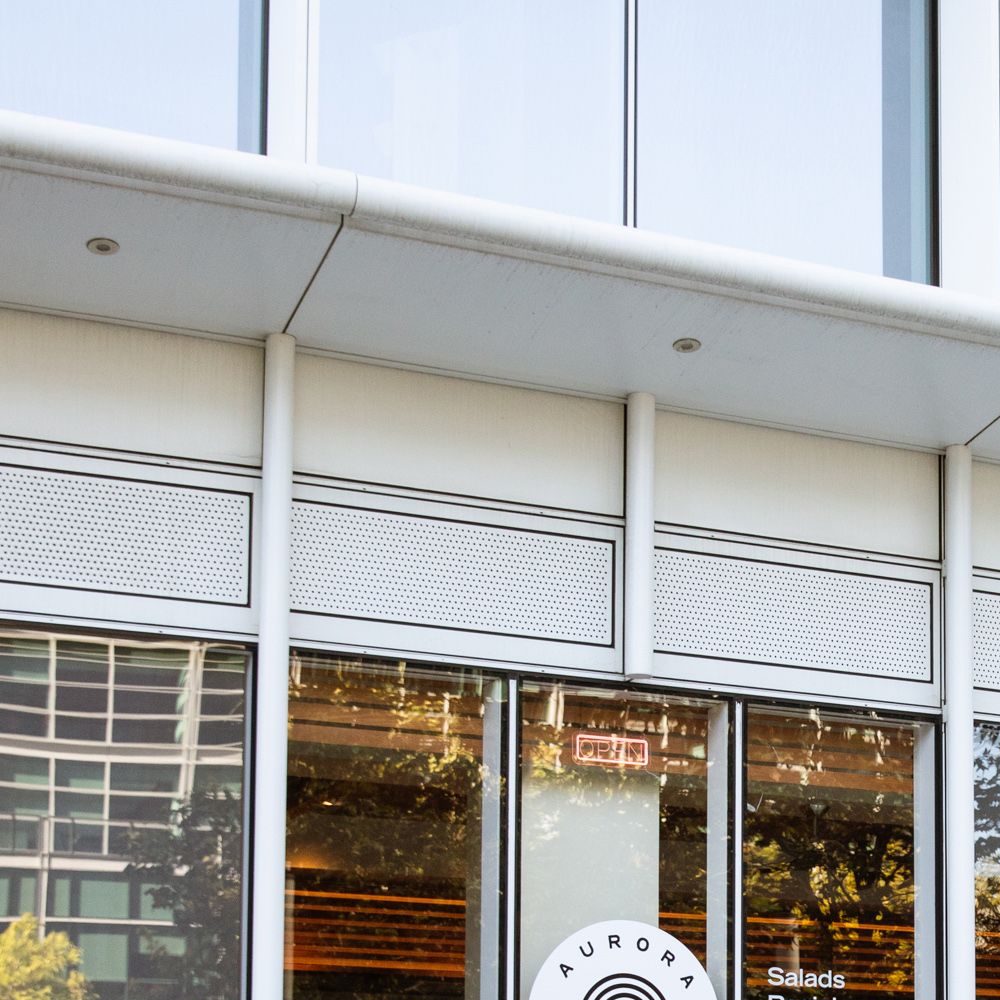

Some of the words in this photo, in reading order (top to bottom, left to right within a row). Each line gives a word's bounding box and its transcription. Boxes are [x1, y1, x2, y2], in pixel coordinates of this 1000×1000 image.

[580, 739, 643, 762] OPEN
[559, 934, 694, 989] AURORA
[767, 966, 846, 989] Salads
